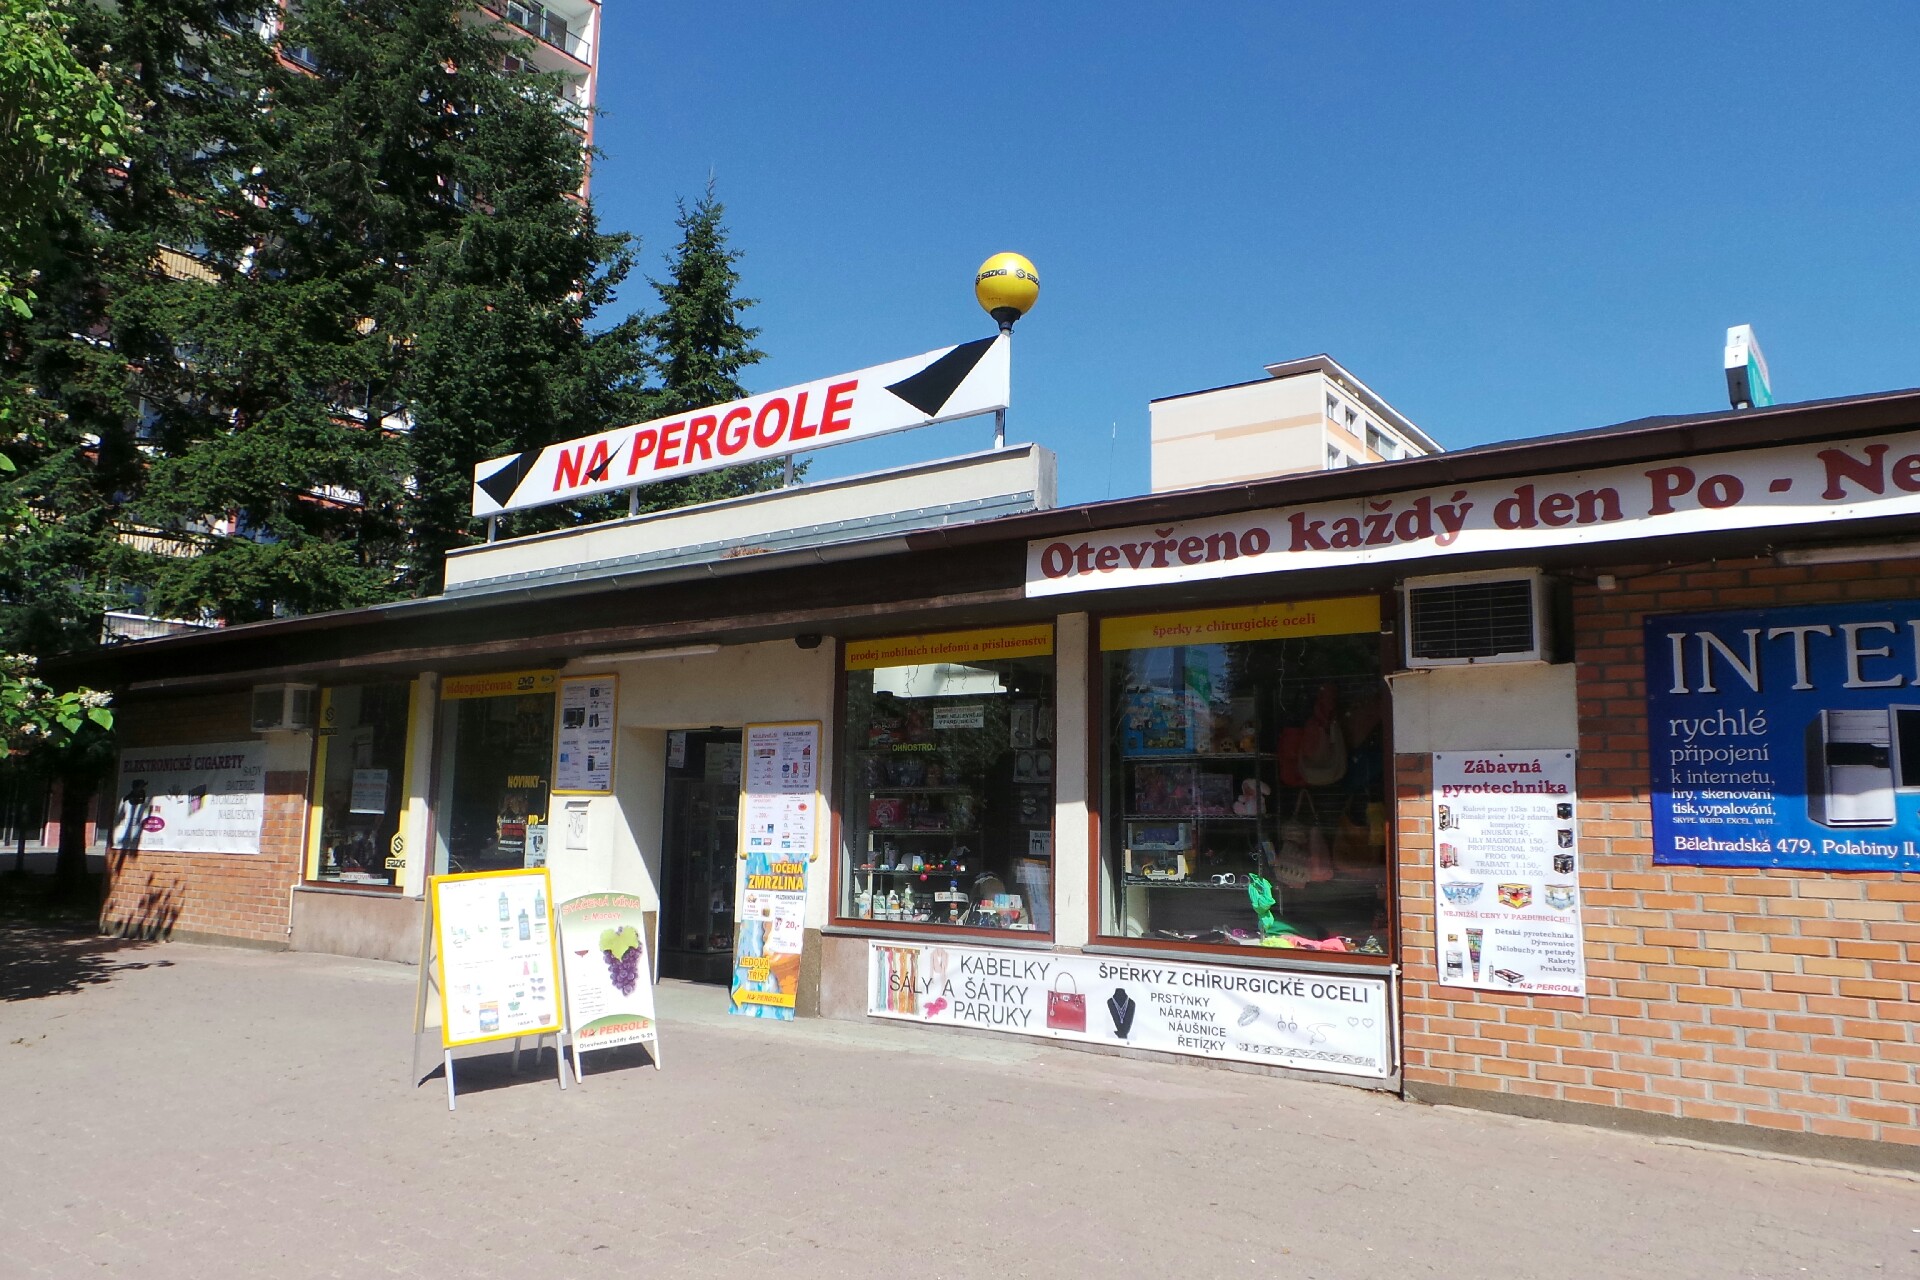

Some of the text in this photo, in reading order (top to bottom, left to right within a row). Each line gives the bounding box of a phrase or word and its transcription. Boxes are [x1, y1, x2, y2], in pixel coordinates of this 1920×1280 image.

[552, 379, 858, 492] NA PERGOLE
[1040, 526, 1271, 579] Otevřeno
[1286, 490, 1473, 553] každý
[1493, 484, 1624, 530] den
[1644, 466, 1744, 516] Po
[1817, 444, 1920, 501] Ne
[1153, 624, 1192, 638] šperky
[1206, 615, 1279, 632] chirurgické
[1283, 613, 1316, 626] oceli
[850, 649, 879, 664] prodej
[882, 645, 928, 659] mobilních
[930, 642, 970, 654] telefonů
[982, 635, 1047, 654] příslušenství
[1669, 708, 1768, 743] rychlé
[892, 743, 938, 752] OHŇOSTROJ
[1671, 743, 1770, 766] připojení
[123, 754, 245, 773] ELEKTRONICKÉ CIGARETY
[1464, 759, 1542, 774] Zábavná
[226, 780, 256, 790] BATERIE
[508, 776, 540, 788] NOVINKY
[1672, 769, 1776, 786] k internetu,
[1442, 780, 1568, 797] pyrotechnika
[1672, 788, 1776, 802] hry, skenování,
[210, 795, 250, 806] ATOMIZERY
[1488, 806, 1508, 814] pumy
[1480, 828, 1512, 836] HNUSÁK
[1674, 836, 1771, 854] Bělehradská
[1776, 839, 1816, 856] 479,
[1822, 840, 1898, 860] Polabiny
[772, 861, 803, 874] TOČENÁ
[1476, 860, 1510, 868] TRABANT
[1470, 868, 1517, 876] BARRACUDA
[748, 875, 804, 890] ZMRZLINA
[612, 894, 640, 910] VÍNA
[592, 912, 622, 920] Moravy
[1444, 909, 1478, 918] NEJNIŽŠÍ
[1495, 928, 1574, 939] Dětská pyrotechnika
[1531, 939, 1575, 948] Dýmovnice
[1496, 945, 1535, 954] Dělobuchy
[1544, 948, 1576, 958] petardy
[740, 956, 769, 967] LEDOVÁ
[960, 955, 1050, 981] KABELKY
[1548, 958, 1576, 966] Rakety
[1540, 966, 1577, 974] Prskavky
[890, 969, 1028, 1005] ŠÁLY A ŠÁTKY
[1098, 962, 1369, 1003] ŠPERKY Z CHIRURGICKÉ OCELI
[1150, 992, 1210, 1008] PRSTÝNKY
[954, 1000, 1032, 1028] PARUKY
[1159, 1006, 1216, 1023] NÁRAMKY
[579, 1020, 649, 1039] NA PERGOLE
[1168, 1021, 1226, 1038] NÁUŠNICE
[1177, 1035, 1226, 1051] ŘETÍZKY
